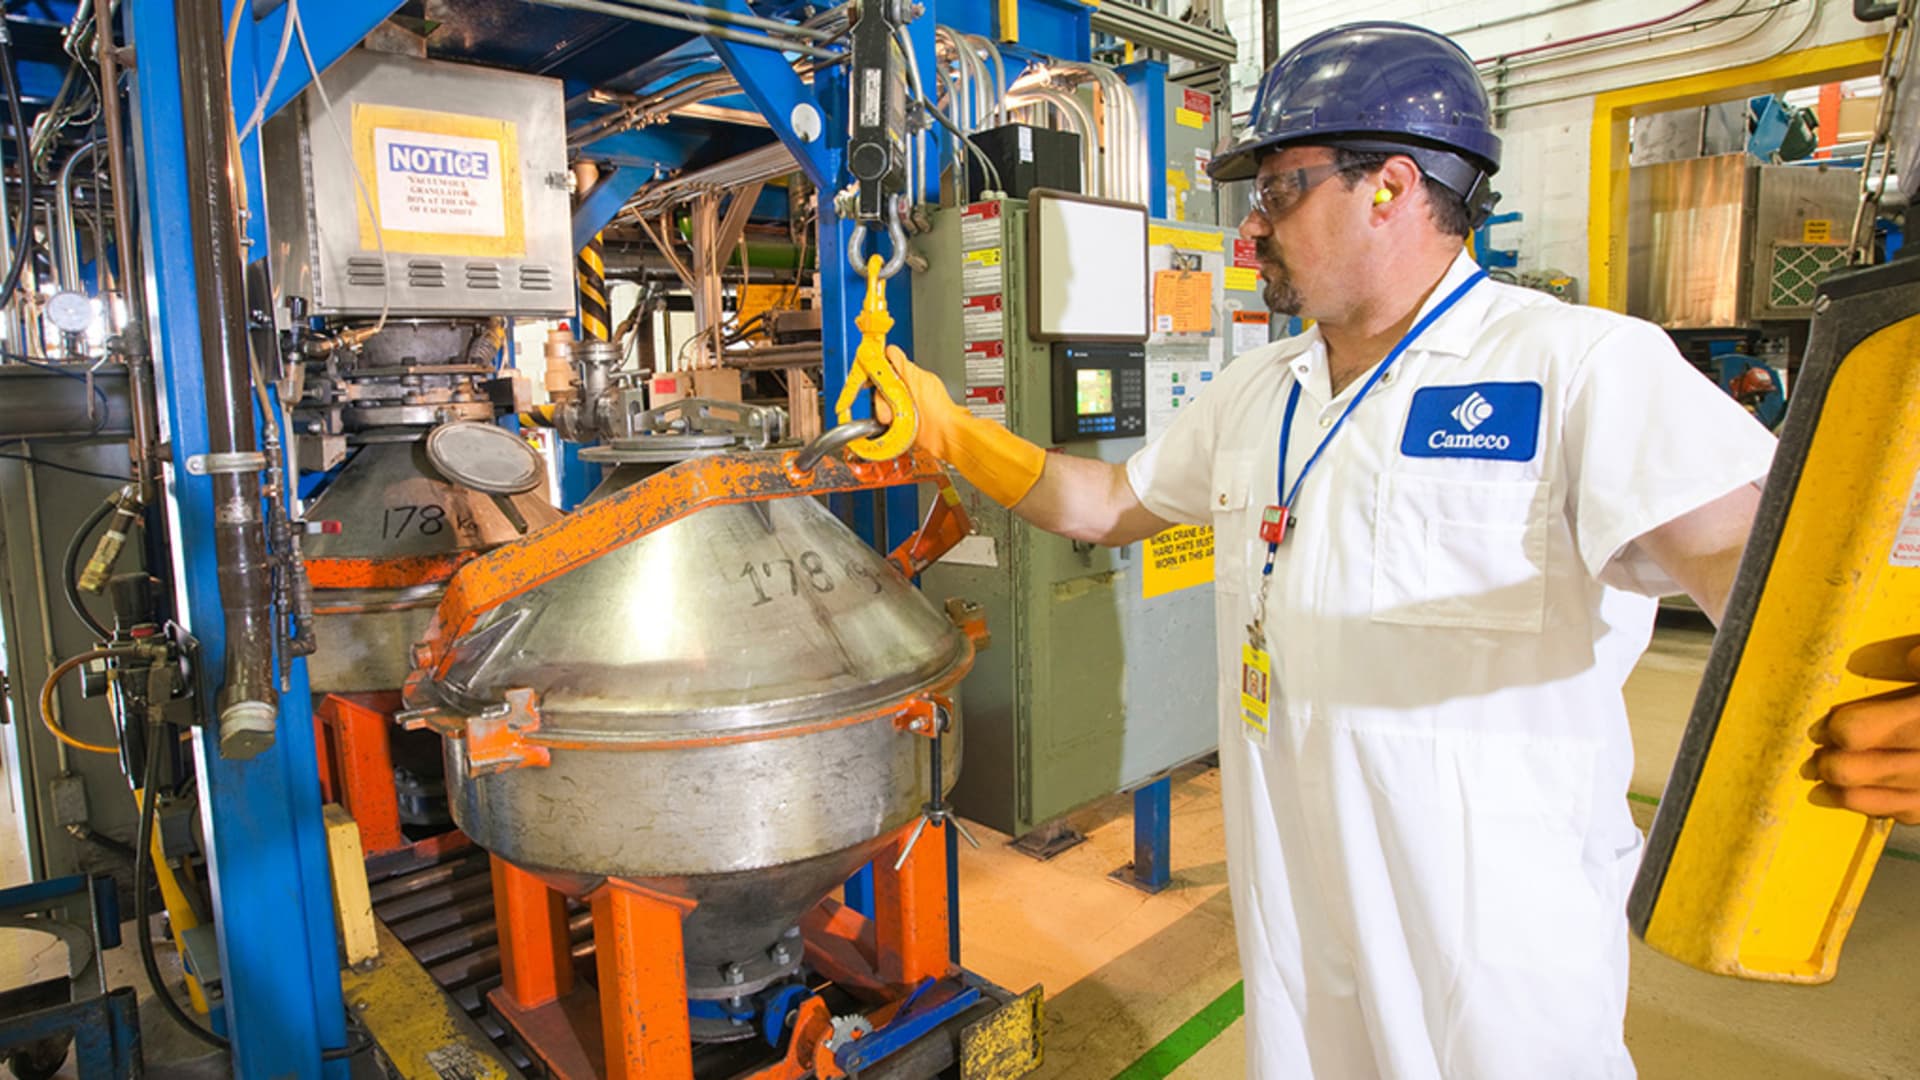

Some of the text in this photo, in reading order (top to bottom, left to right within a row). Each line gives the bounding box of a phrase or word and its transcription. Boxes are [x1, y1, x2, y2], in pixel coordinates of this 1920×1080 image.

[391, 146, 486, 176] NOTICE
[409, 205, 420, 213] OF
[423, 206, 447, 214] EACH
[428, 197, 439, 205] AT
[441, 198, 456, 206] THE
[1427, 429, 1511, 450] Cameco
[382, 504, 446, 539] 178
[1173, 528, 1197, 541] CRANE
[1153, 544, 1174, 557] HARD
[1175, 540, 1194, 552] HATS
[1155, 557, 1178, 569] WORN
[1179, 554, 1187, 564] IN
[1188, 549, 1204, 561] THIS
